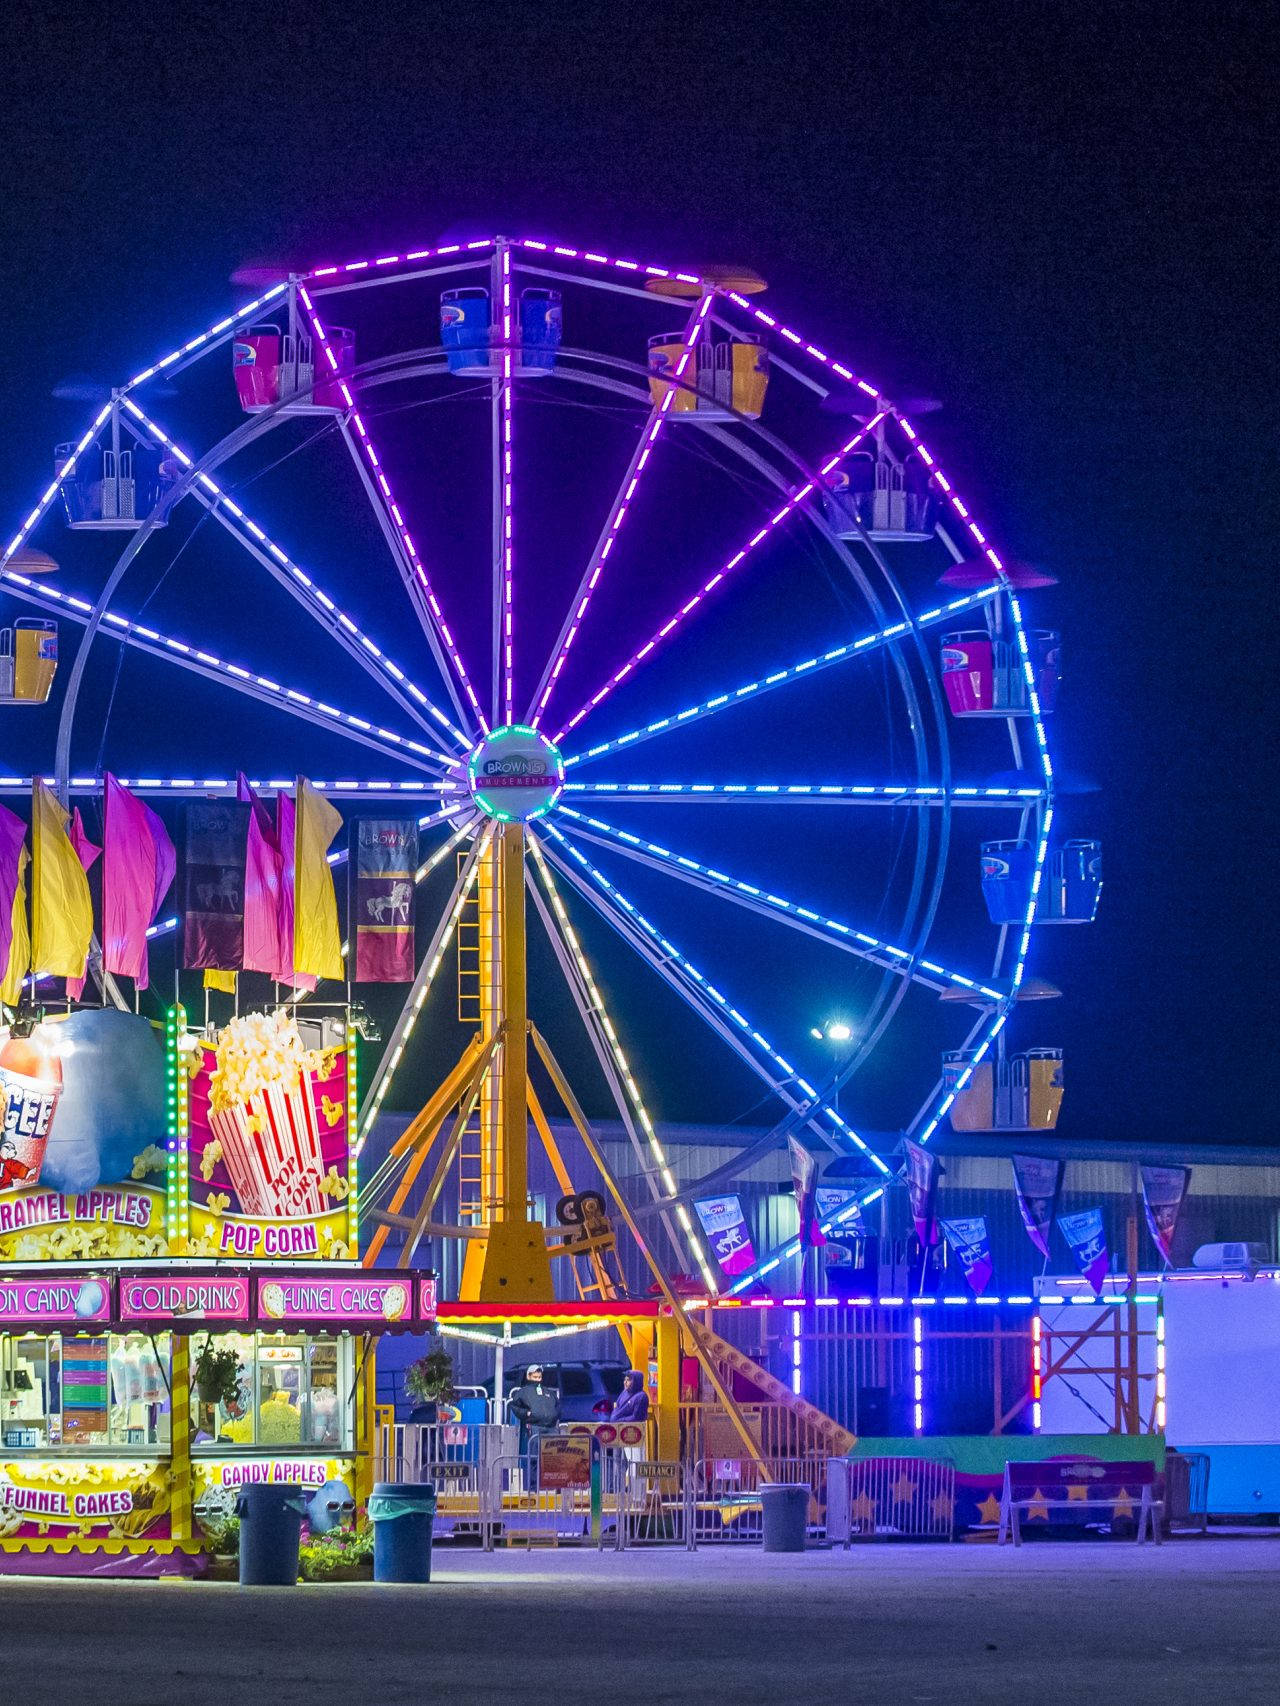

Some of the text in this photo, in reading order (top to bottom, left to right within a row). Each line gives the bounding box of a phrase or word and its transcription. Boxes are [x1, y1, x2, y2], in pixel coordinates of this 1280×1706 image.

[478, 777, 554, 786] AMUSEMENTS
[272, 1156, 295, 1199] POP
[74, 1190, 152, 1227] APPLES
[221, 1221, 318, 1254] POP CORN
[24, 1287, 83, 1312] CANDY
[129, 1286, 241, 1311] COLD DRINKS
[282, 1287, 387, 1312] FUNNEL CAKES
[222, 1462, 327, 1487] CANDY APPLES
[435, 1465, 464, 1478] EXIT
[639, 1465, 674, 1477] ENTRANCE
[4, 1486, 134, 1517] FUNNEL CAKES
